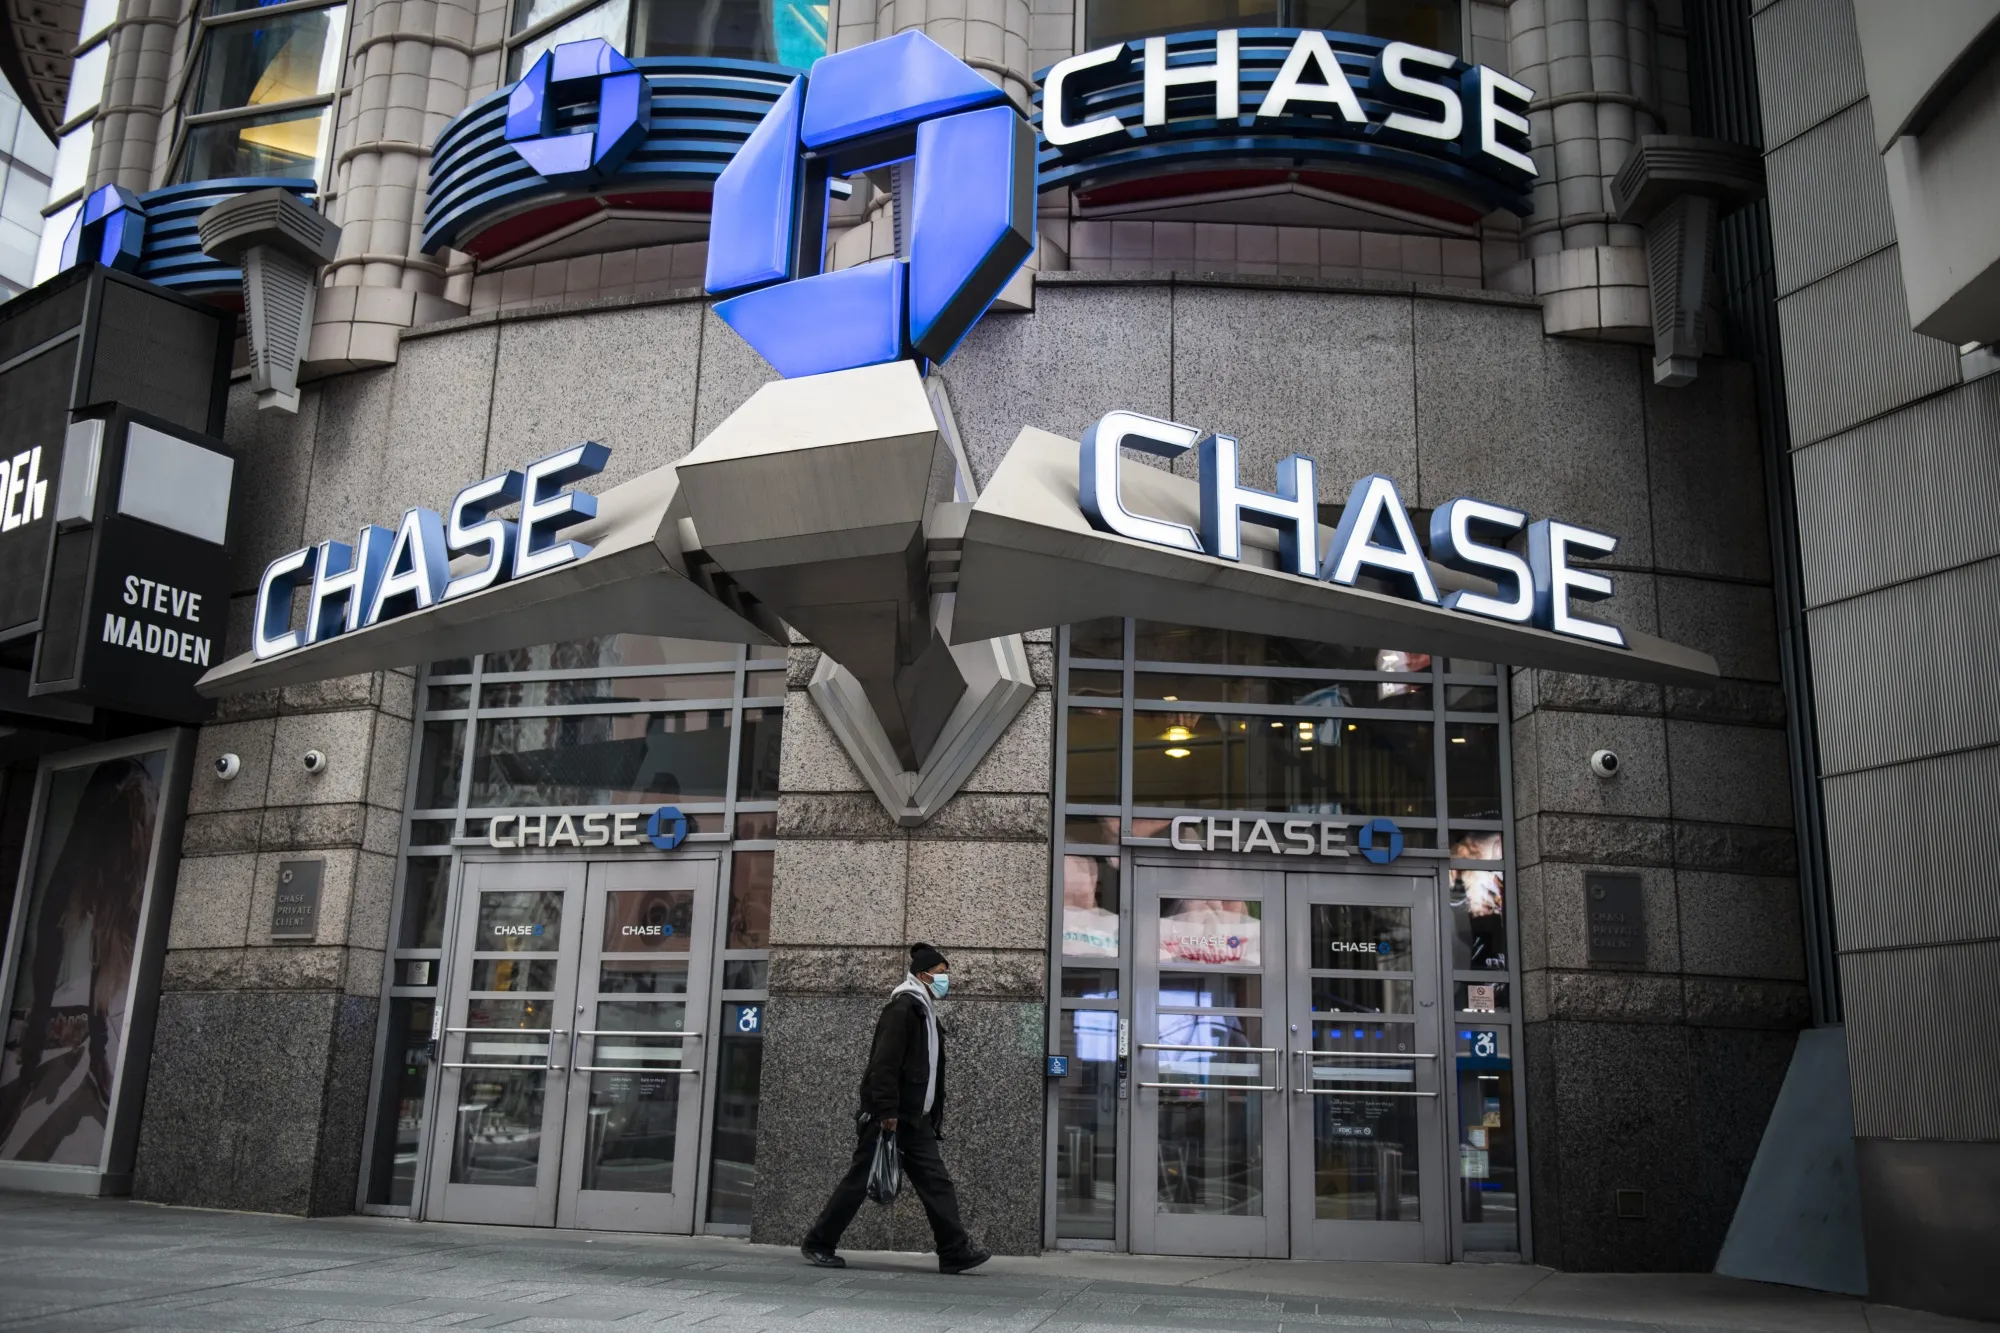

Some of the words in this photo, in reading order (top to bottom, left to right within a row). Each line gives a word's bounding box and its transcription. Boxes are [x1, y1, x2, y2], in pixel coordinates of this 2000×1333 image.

[1042, 29, 1540, 179] CHASE
[1079, 410, 1629, 650] CHASE
[252, 441, 611, 660] CHASE
[123, 574, 202, 623] STEVE
[102, 613, 211, 667] MADDEN
[490, 812, 642, 848] CHASE
[1171, 815, 1350, 857] CHASE
[277, 906, 312, 915] PRIVATE
[279, 894, 305, 903] CHASE
[275, 917, 305, 927] CLIENT
[494, 925, 533, 935] CHASE
[622, 925, 662, 936] CHASE
[1180, 935, 1227, 948] CHASE
[1331, 941, 1376, 953] CHASE
